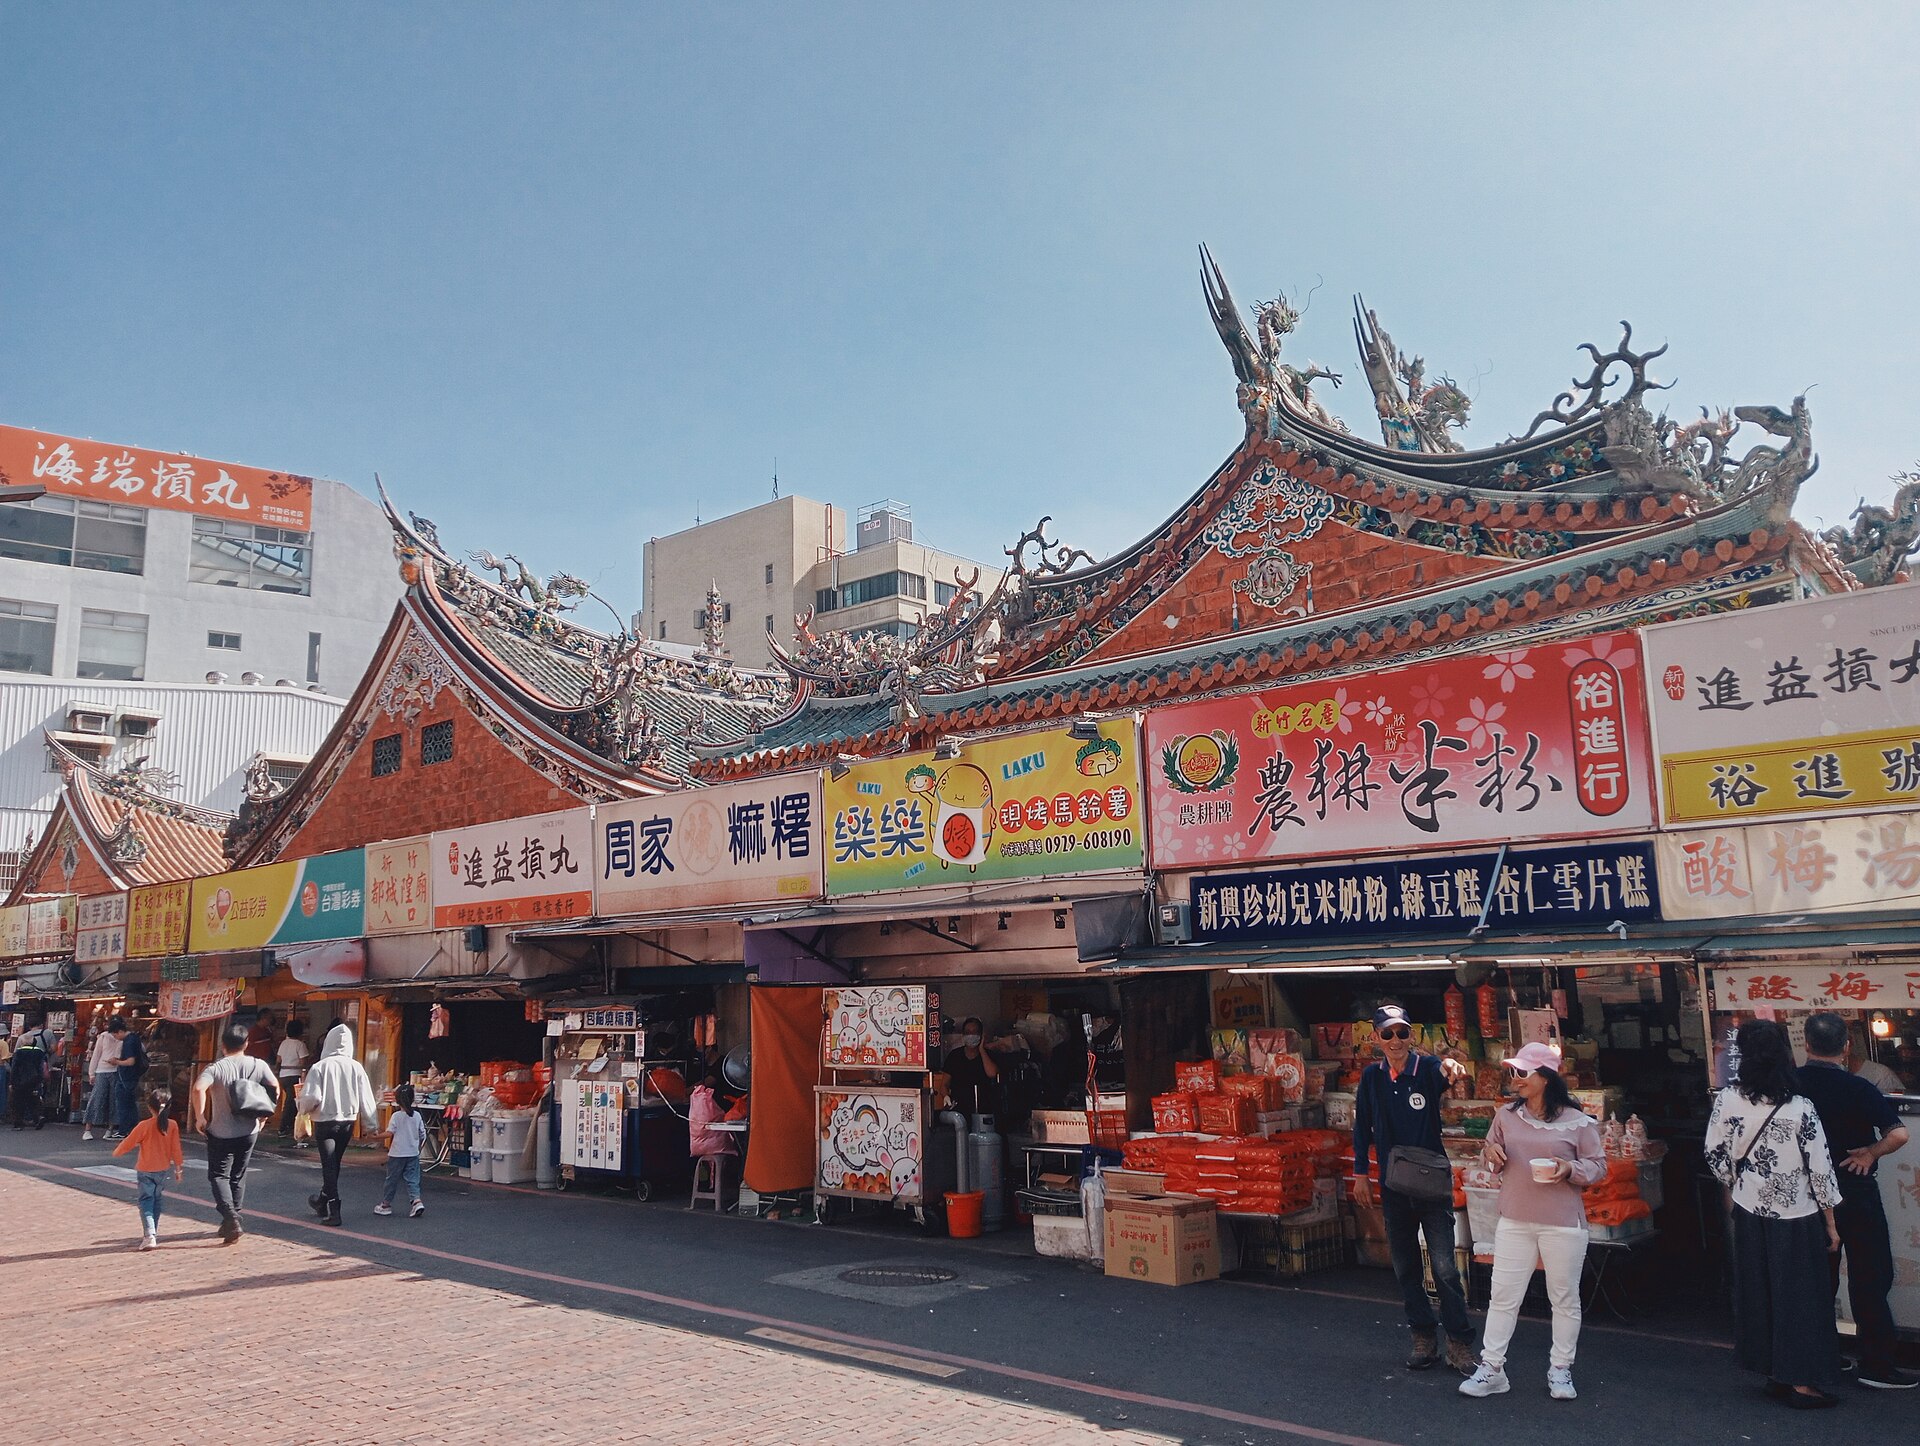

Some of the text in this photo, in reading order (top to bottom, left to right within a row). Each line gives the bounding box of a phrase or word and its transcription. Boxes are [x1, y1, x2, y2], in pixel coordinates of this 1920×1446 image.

[1869, 626, 1899, 638] SINCE
[1664, 668, 1685, 699] 新竹
[1254, 703, 1334, 734] 新竹名產
[1573, 670, 1624, 802] 裕進行
[1002, 751, 1046, 782] LAKU
[1249, 720, 1562, 837] 農耕米粉
[856, 782, 882, 795] LAKU
[1000, 786, 1130, 830] 現烤馬鈴薯
[1178, 801, 1233, 827] 農耕牌
[834, 798, 926, 862] 樂樂
[1045, 829, 1131, 854] 0929-608190
[463, 834, 579, 889] 進益摃丸
[604, 813, 676, 880] 周家
[1681, 821, 1920, 898] 酸梅湯
[382, 850, 418, 875] 新竹
[904, 862, 926, 879] LAKU
[321, 889, 361, 913] 台灣彩券
[371, 872, 427, 909] 都城隍廟
[230, 896, 267, 920] 公益彩券
[382, 907, 416, 924] 入口
[1747, 972, 1920, 1002] 酸梅
